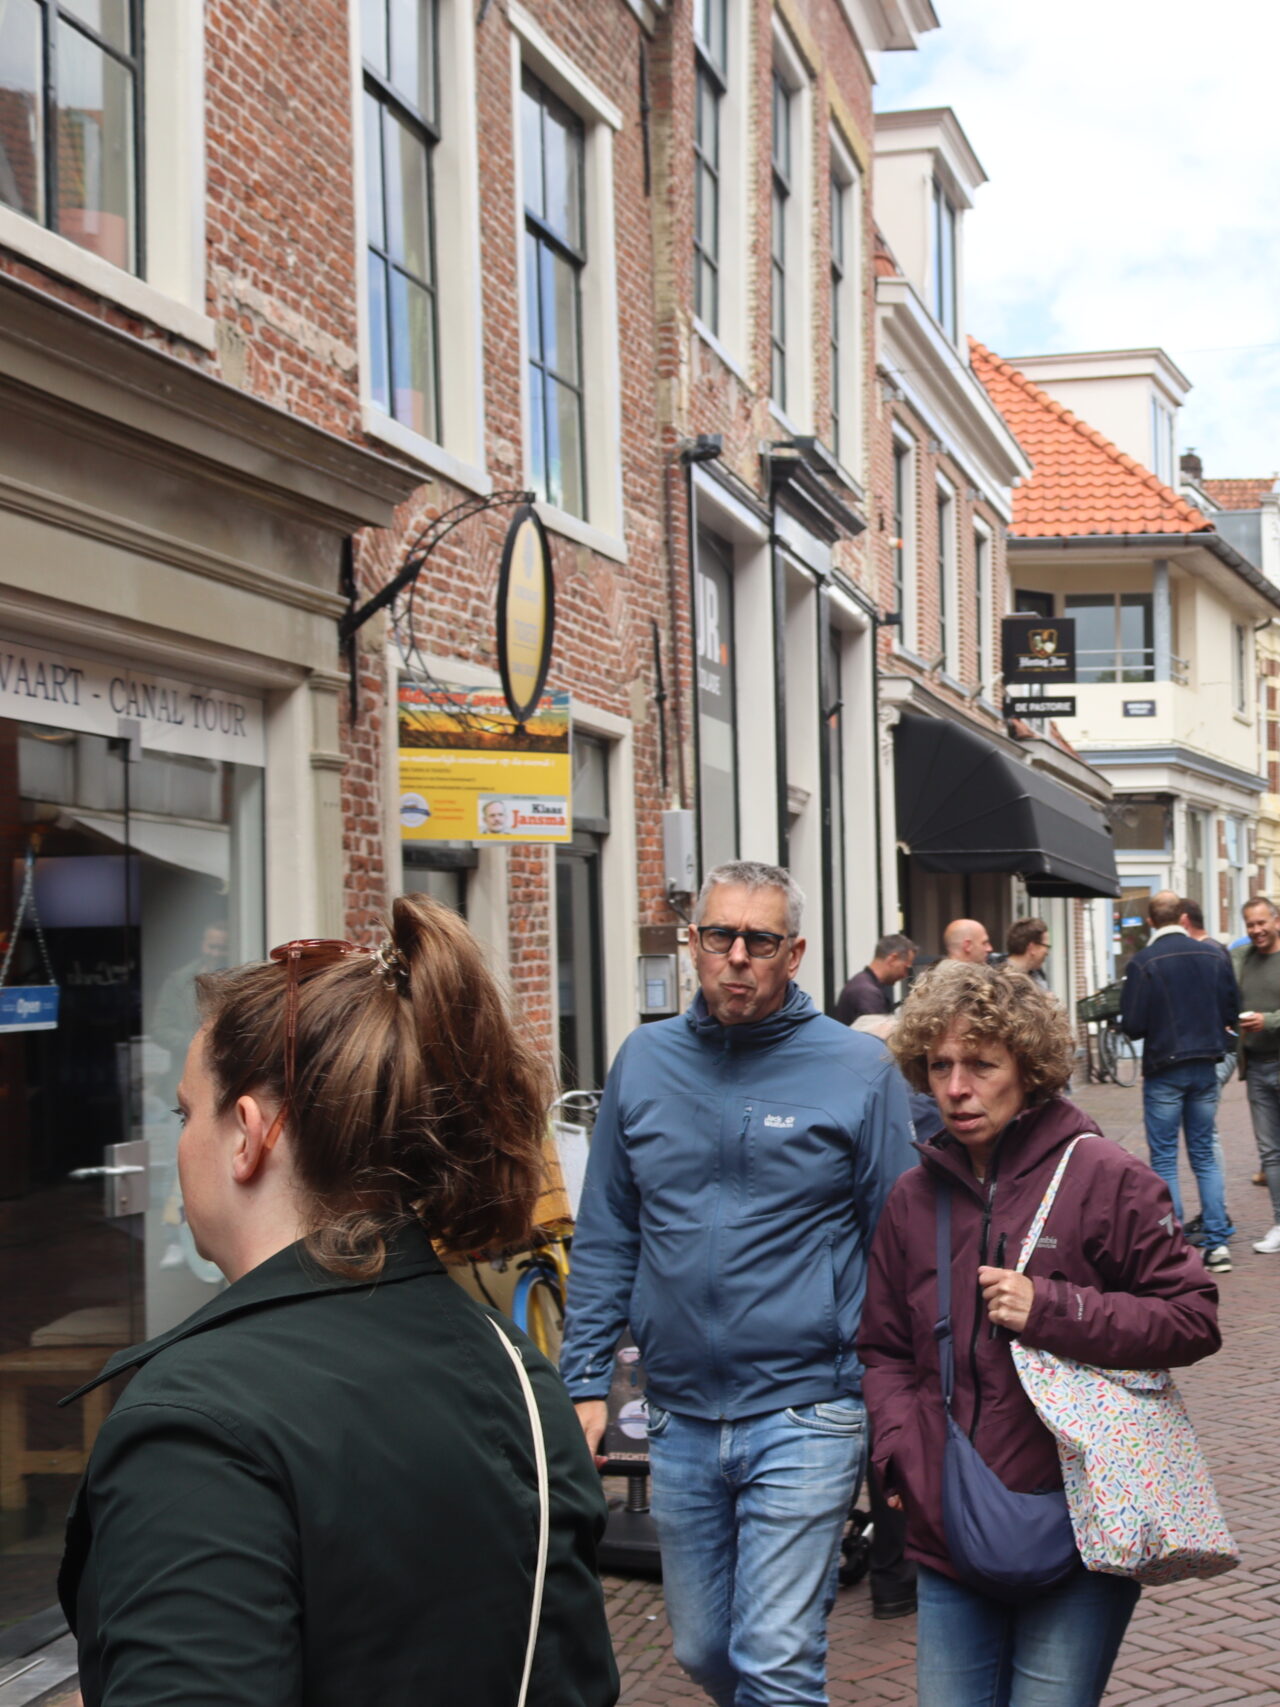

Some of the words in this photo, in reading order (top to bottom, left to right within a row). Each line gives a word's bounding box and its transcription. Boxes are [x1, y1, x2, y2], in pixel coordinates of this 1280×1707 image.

[109, 677, 184, 725] CANAL
[189, 694, 247, 737] TOUR
[1029, 701, 1072, 712] PASTORIE
[532, 803, 563, 815] Klaas
[511, 810, 566, 829] Jansma
